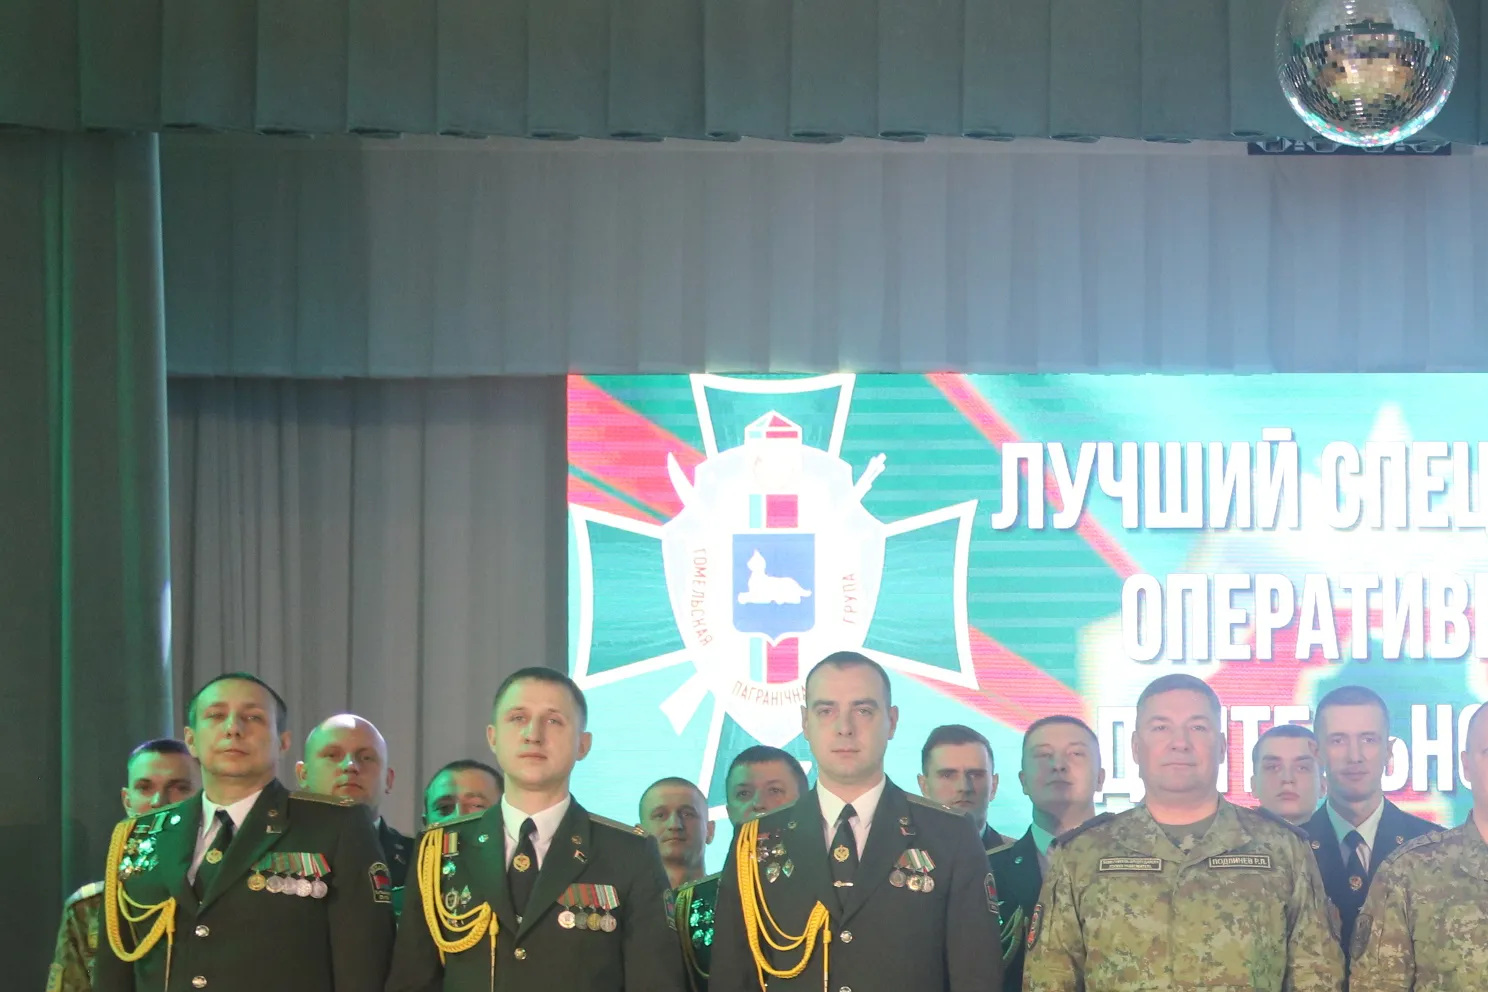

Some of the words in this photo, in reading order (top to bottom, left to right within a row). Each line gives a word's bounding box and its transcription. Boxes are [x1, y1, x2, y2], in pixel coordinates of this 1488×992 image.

[991, 427, 1302, 529] ЛУЧШИЙ
[691, 548, 713, 647] ГОМЕЛЬСКАЯ
[732, 680, 808, 706] ПАГРАНІЧНА
